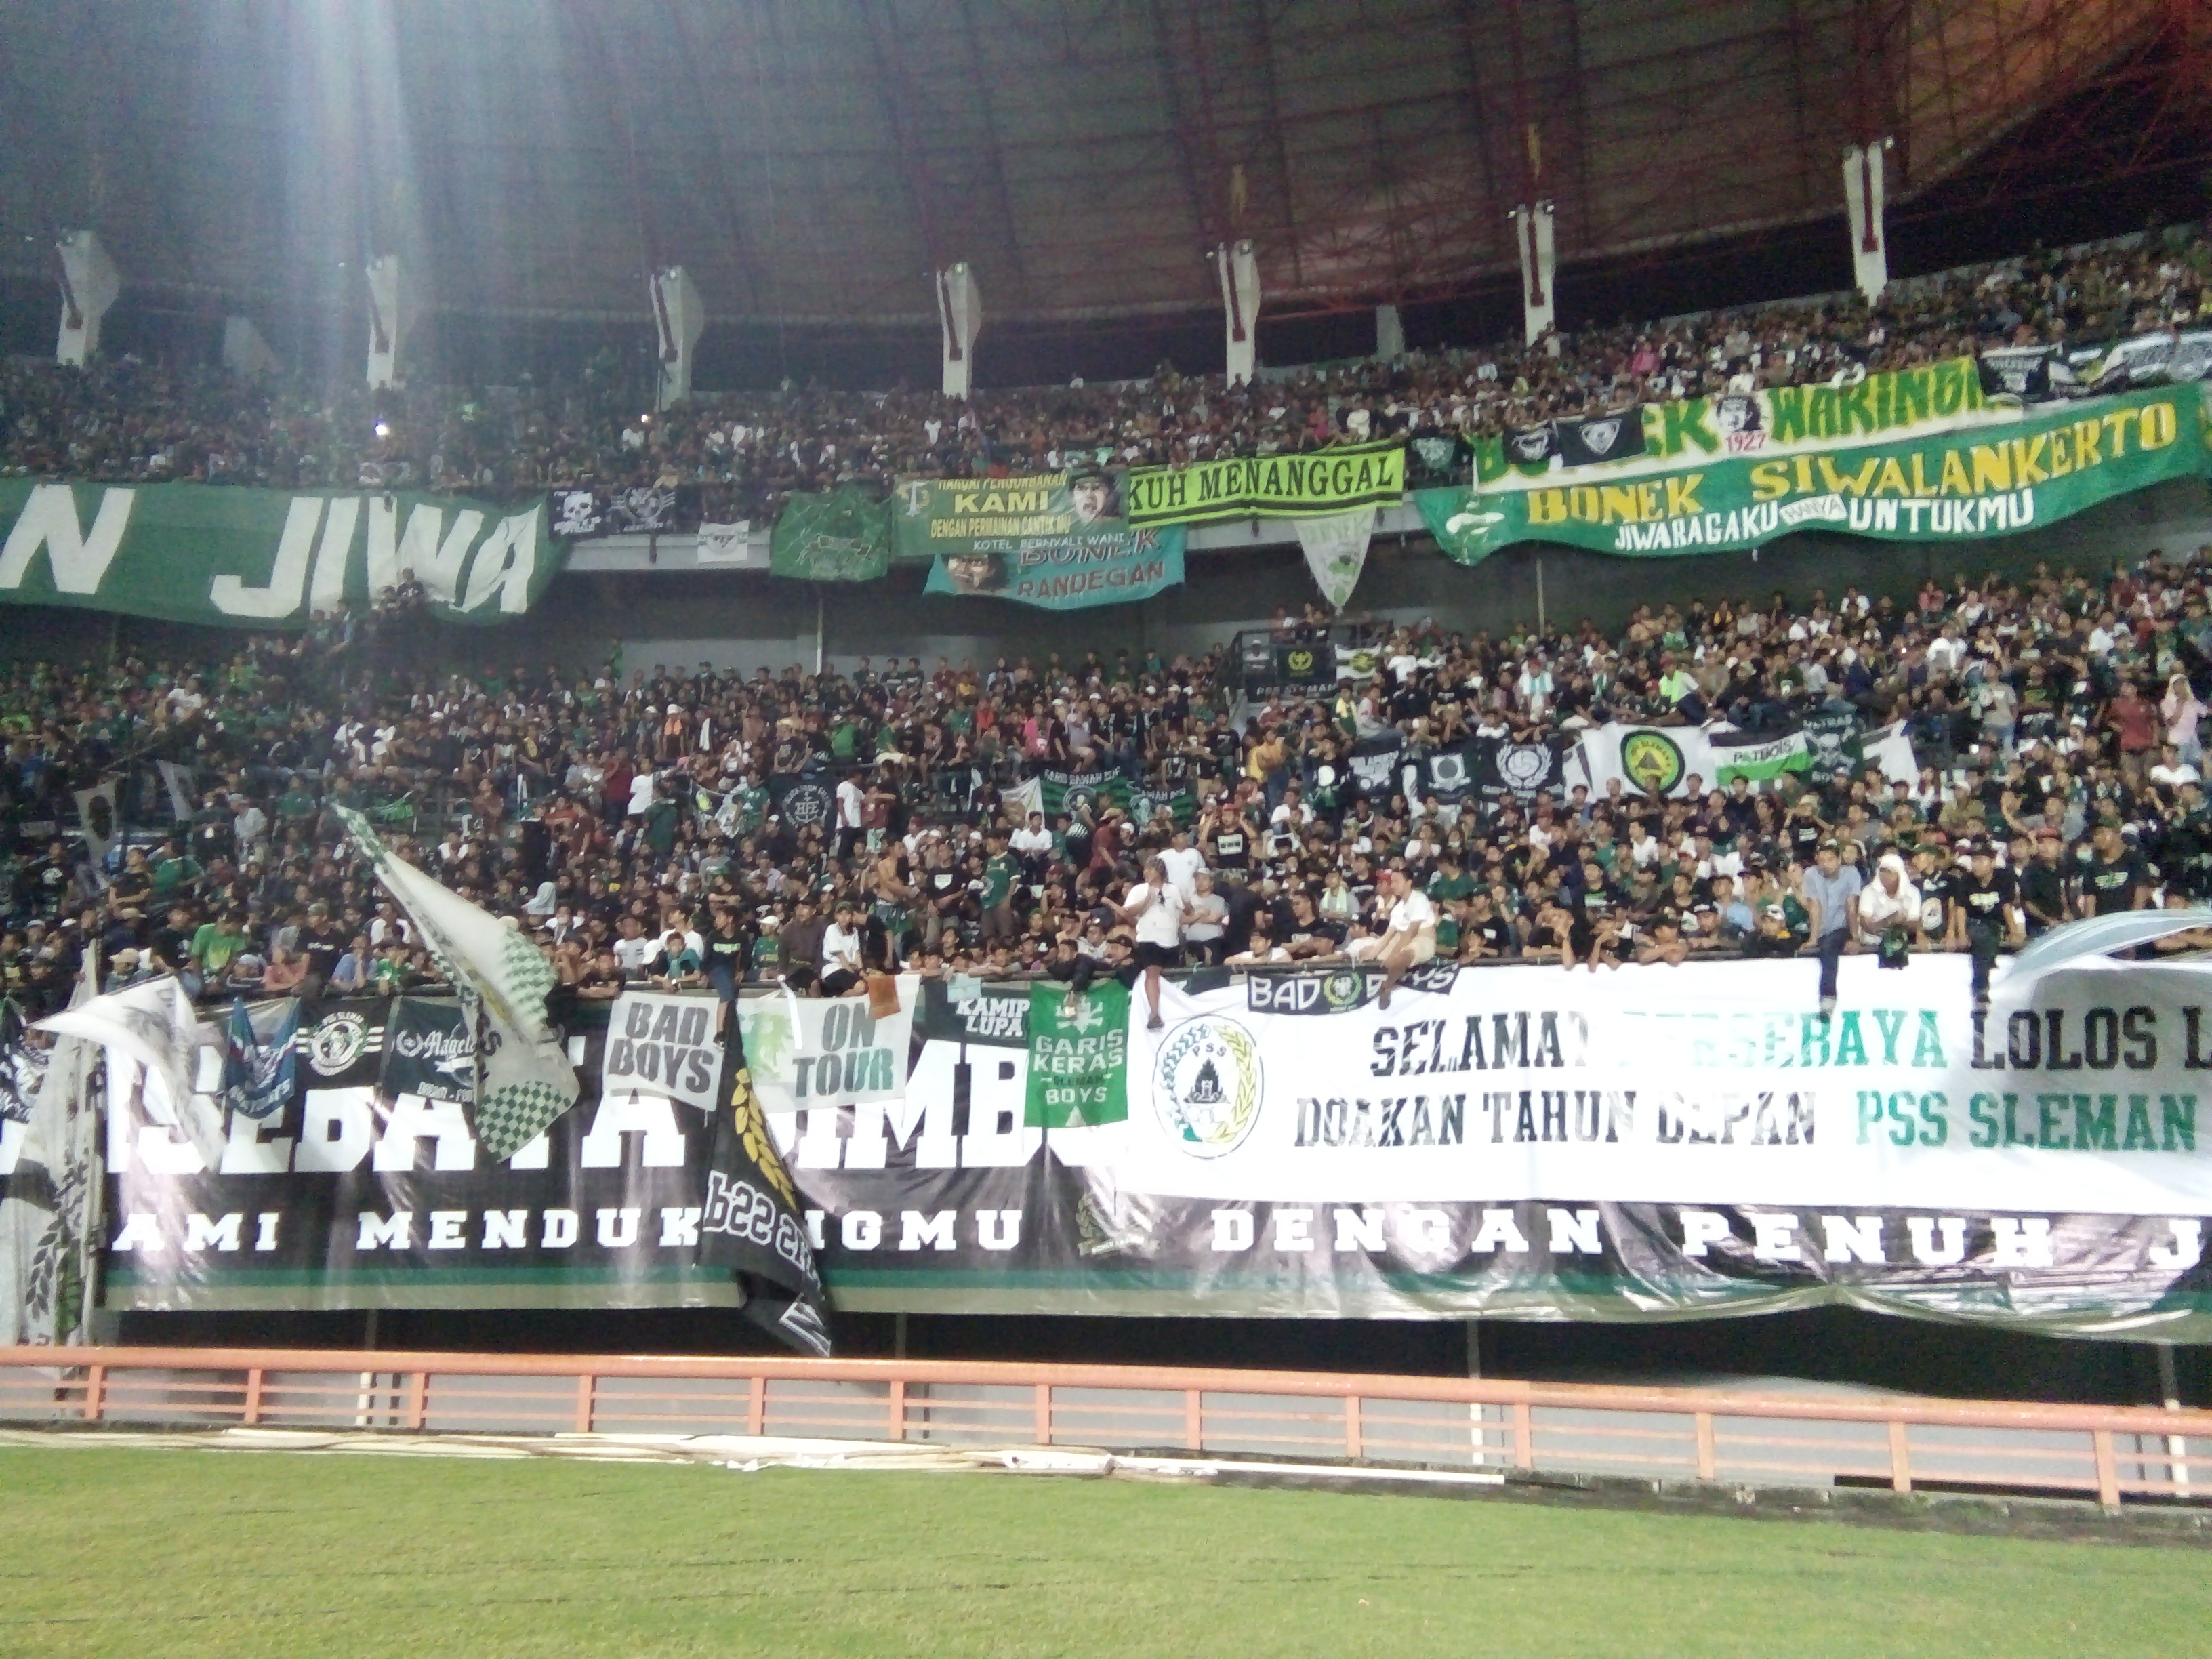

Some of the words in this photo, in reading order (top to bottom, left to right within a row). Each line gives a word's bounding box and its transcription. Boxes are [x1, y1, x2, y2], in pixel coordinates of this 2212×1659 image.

[1528, 474, 1704, 525] BONEK
[1751, 403, 2177, 501] SIWALANKERTO
[1725, 431, 1767, 453] 1927
[1199, 455, 1395, 501] MENANGGAL
[954, 491, 1048, 513] KAMI
[1615, 499, 1780, 552] JIWARAGAKU
[1849, 487, 2034, 534] UNTUKMU
[210, 497, 541, 619] JIWA
[1250, 974, 1321, 1010] BAD
[1366, 964, 1458, 1000] BYS
[625, 1002, 708, 1046] BAD
[822, 1004, 876, 1052] ON
[965, 1015, 1023, 1037] LUPA
[1035, 1029, 1124, 1054] GARIS
[1970, 1005, 2157, 1070] LOLOS
[609, 1039, 720, 1092] BOYS
[1033, 1048, 1123, 1074] KERAS
[1192, 1042, 1228, 1057] PSS
[792, 1048, 894, 1098] TOUR
[1046, 1086, 1107, 1105] BOYS
[1295, 1092, 1466, 1147] DOAKAN
[1482, 1090, 1637, 1143] TAHUN
[1856, 1089, 1948, 1147] PSS
[1969, 1091, 2198, 1151] SLEMAN
[111, 1212, 279, 1252] AMI
[1210, 1208, 1602, 1255] DENGAN
[1680, 1212, 2053, 1267] PENUH
